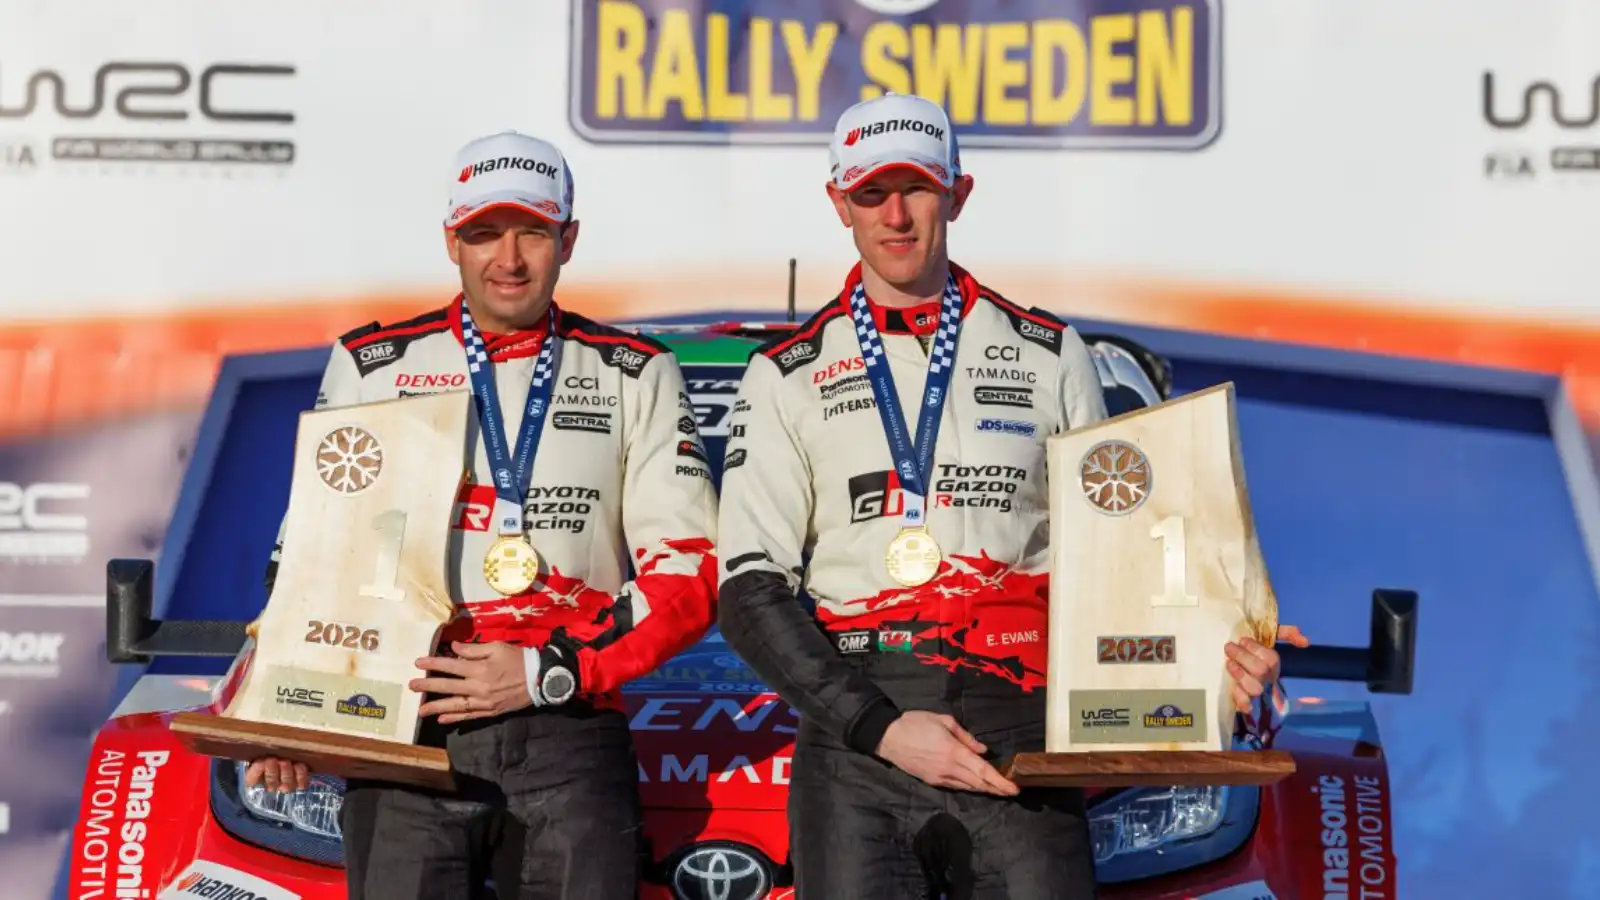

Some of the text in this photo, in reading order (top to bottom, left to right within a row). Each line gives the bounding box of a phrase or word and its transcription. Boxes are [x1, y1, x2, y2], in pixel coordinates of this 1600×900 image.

[596, 3, 1195, 127] RALLY SWEDEN
[1021, 323, 1055, 339] OMP
[361, 345, 395, 362] OMP
[612, 348, 644, 366] OMP
[781, 345, 813, 364] OMP
[813, 356, 865, 384] DENS
[966, 367, 1037, 384] TAMADIC
[395, 373, 466, 388] DENSO
[550, 394, 618, 407] TAMADIC
[928, 387, 941, 405] FIA
[974, 388, 1033, 406] CENTRAL
[553, 413, 611, 431] CENTRAL
[976, 419, 1003, 431] JDS
[901, 461, 914, 479] FIA
[938, 464, 1027, 480] TOYOTA
[498, 470, 512, 489] FIA
[936, 479, 1017, 494] GAZOO
[524, 486, 600, 501] OYOTA
[524, 502, 591, 515] AZOO
[934, 494, 1012, 513] Racing
[503, 517, 518, 528] FIA
[522, 516, 586, 533] acing
[359, 509, 408, 601] 1
[1150, 516, 1200, 607] 1
[304, 620, 381, 651] 2026
[838, 634, 869, 650] OMP
[986, 630, 1039, 647] E. EVANS
[1098, 637, 1175, 662] 2026
[652, 667, 713, 681] ALLY
[628, 698, 798, 732] ENS
[79, 749, 126, 900] AUTOMOTIV
[115, 750, 170, 900] Panasoni
[1311, 775, 1349, 900] nasonic
[1354, 775, 1386, 900] TOMOTIVE
